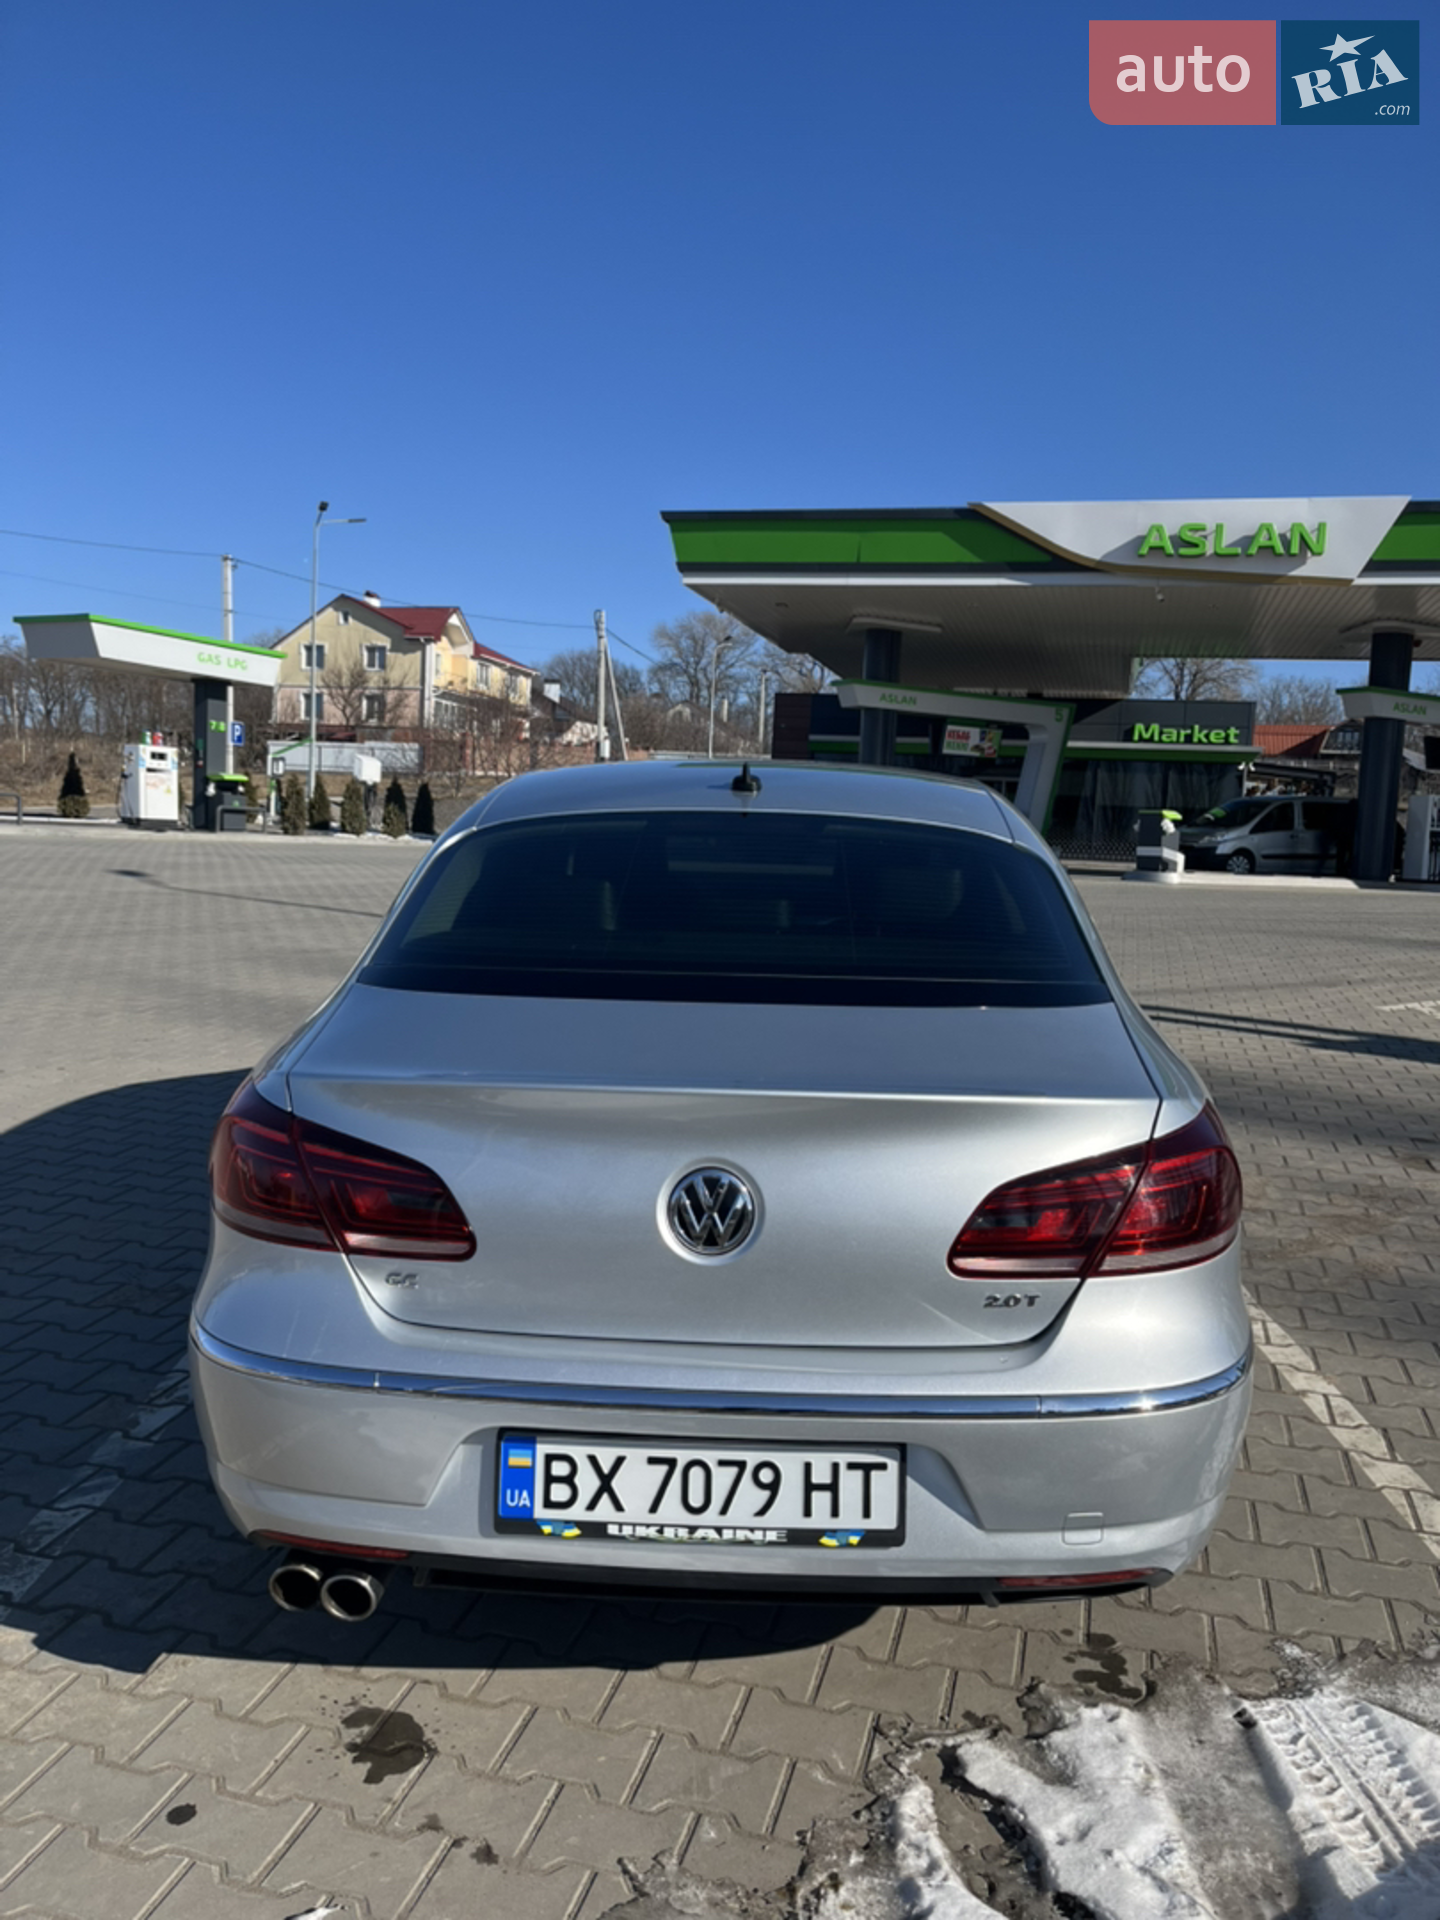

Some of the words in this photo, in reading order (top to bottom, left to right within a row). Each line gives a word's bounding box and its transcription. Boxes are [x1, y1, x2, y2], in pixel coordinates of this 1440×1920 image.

[1137, 521, 1327, 557] ASLAN
[197, 652, 222, 666] GAS
[227, 657, 248, 671] LPG
[879, 692, 917, 707] ASLAN
[1393, 701, 1427, 716] ASLAN
[1133, 723, 1240, 744] Market
[646, 1456, 782, 1517] 7079
[506, 1489, 531, 1507] UA
[607, 1523, 788, 1543] UKRAINE
